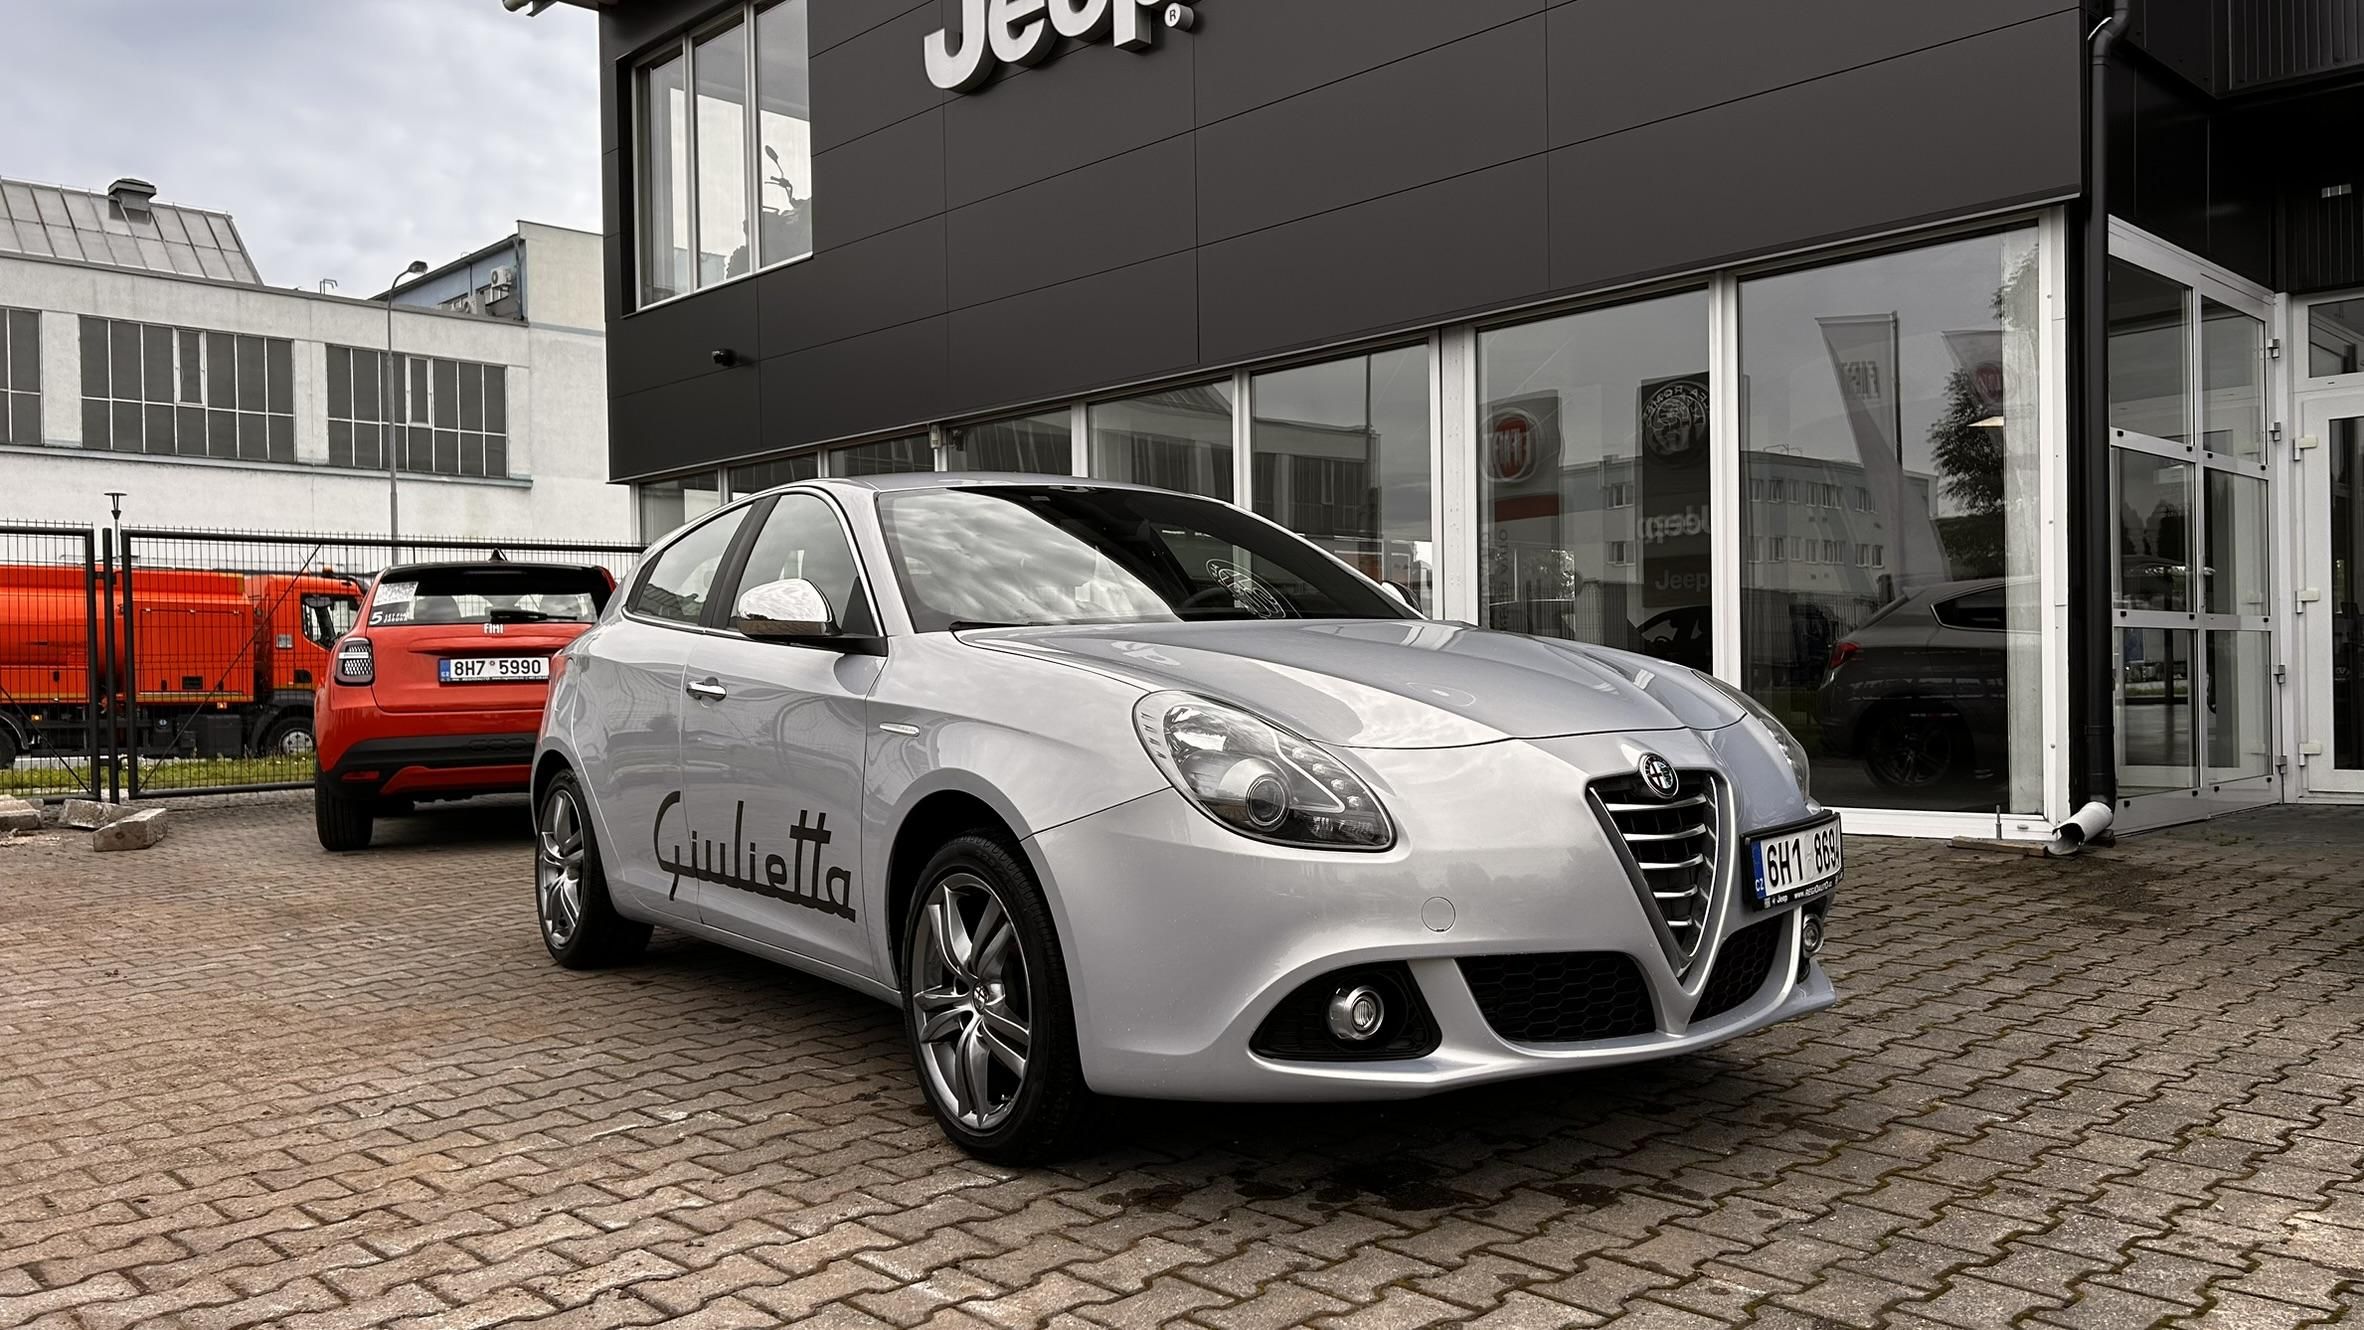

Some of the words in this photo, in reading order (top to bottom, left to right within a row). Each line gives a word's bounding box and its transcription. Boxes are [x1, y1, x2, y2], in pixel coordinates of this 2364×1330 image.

[454, 660, 486, 676] 8H7
[499, 659, 541, 675] 5990
[654, 791, 856, 923] Giulietta
[1755, 877, 1764, 892] CZ
[1767, 838, 1803, 887] 6H1
